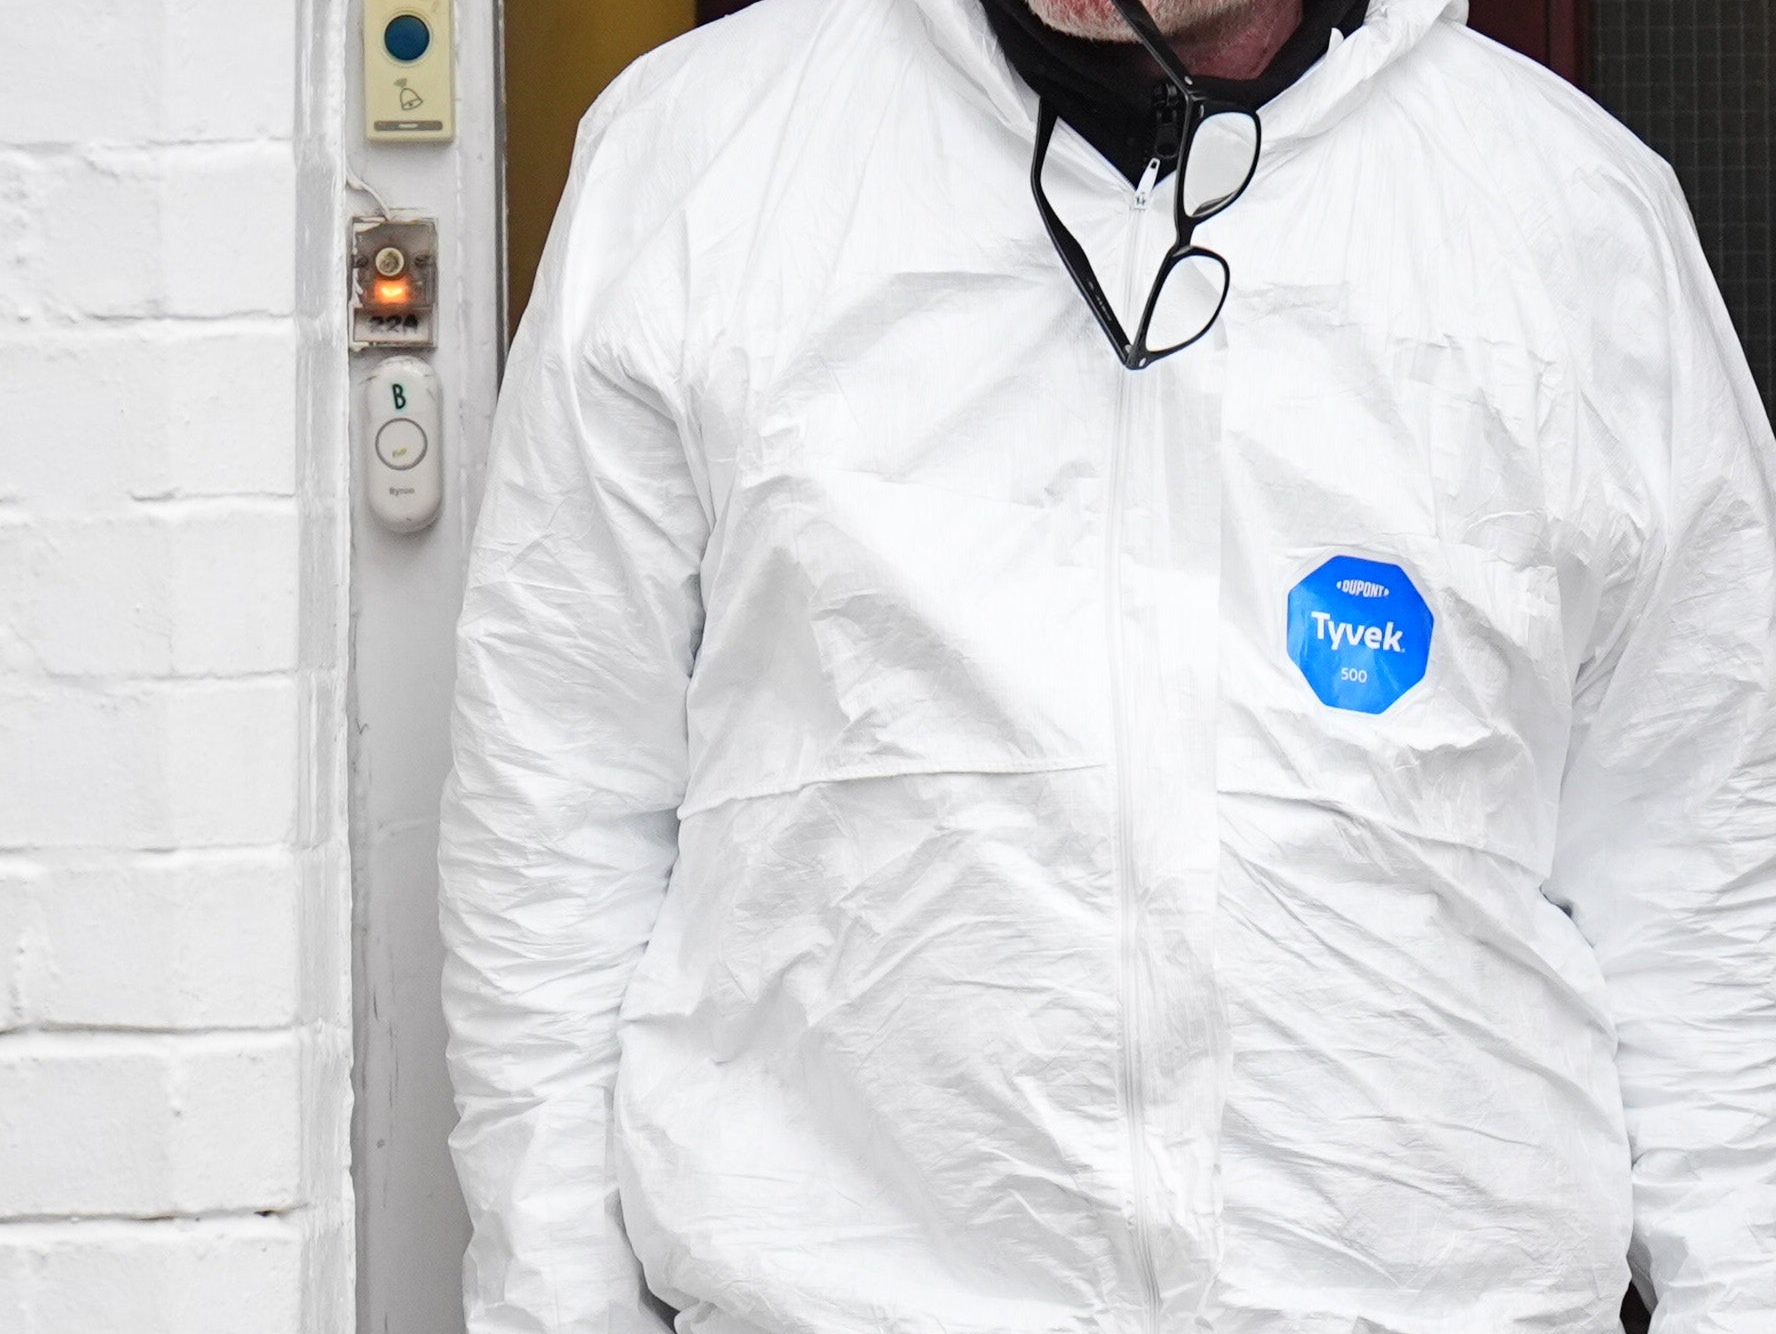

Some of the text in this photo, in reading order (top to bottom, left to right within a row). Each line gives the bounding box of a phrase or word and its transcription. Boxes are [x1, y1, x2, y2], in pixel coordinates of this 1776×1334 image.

[392, 383, 406, 410] B
[1340, 579, 1386, 598] DUPONT
[1311, 610, 1404, 652] Tyvek
[1341, 667, 1368, 683] 500
